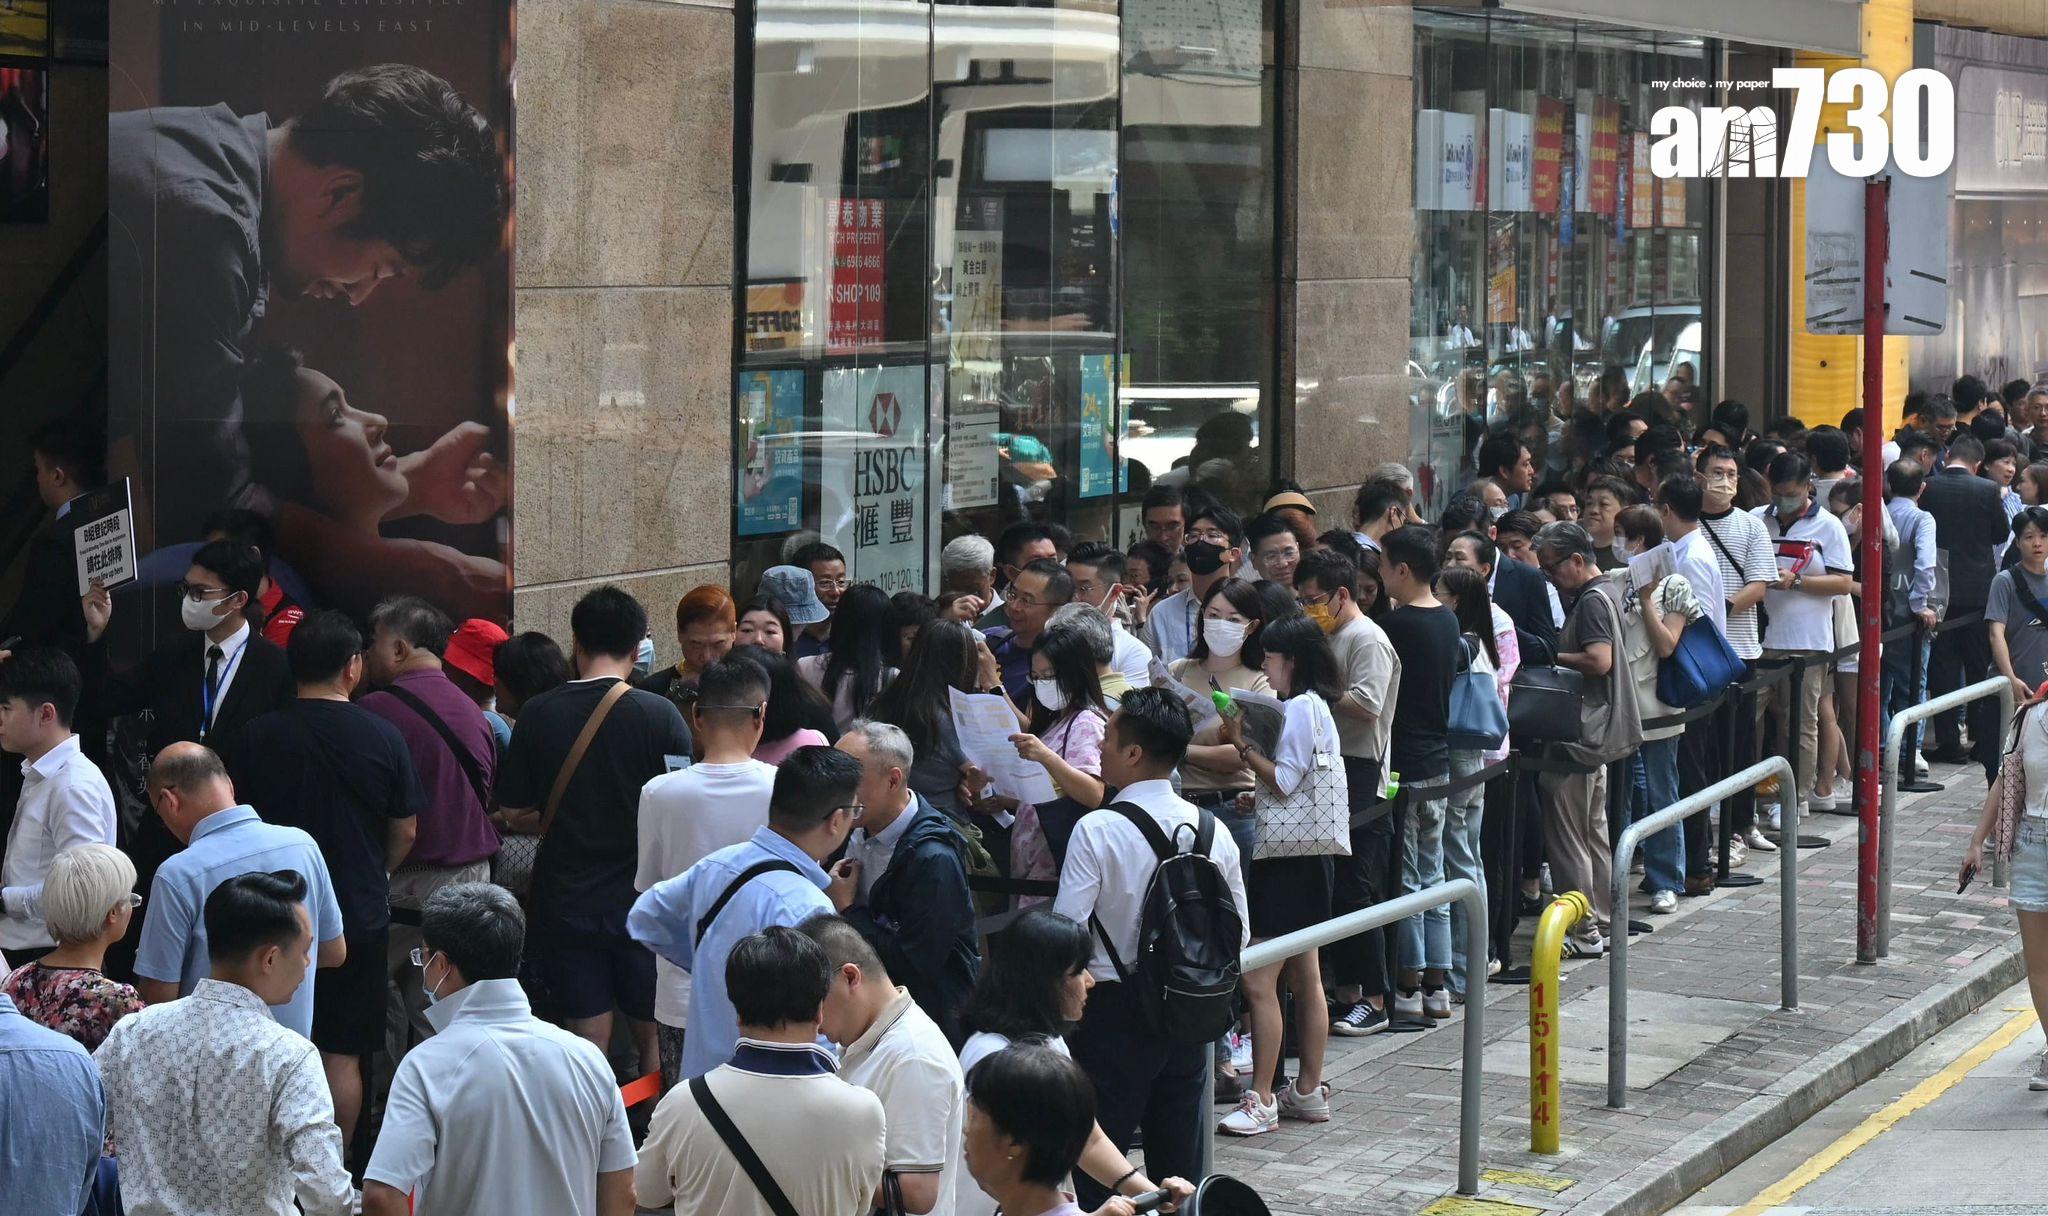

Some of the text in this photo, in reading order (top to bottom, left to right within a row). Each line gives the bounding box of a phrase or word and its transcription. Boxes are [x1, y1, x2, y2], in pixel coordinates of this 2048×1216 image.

[183, 19, 433, 32] IN MID-LEVELS EAST
[828, 231, 846, 245] RCH
[836, 283, 864, 303] SHOP
[864, 283, 881, 303] 109
[853, 446, 916, 498] HSBC
[1532, 982, 1551, 1126] 15114
